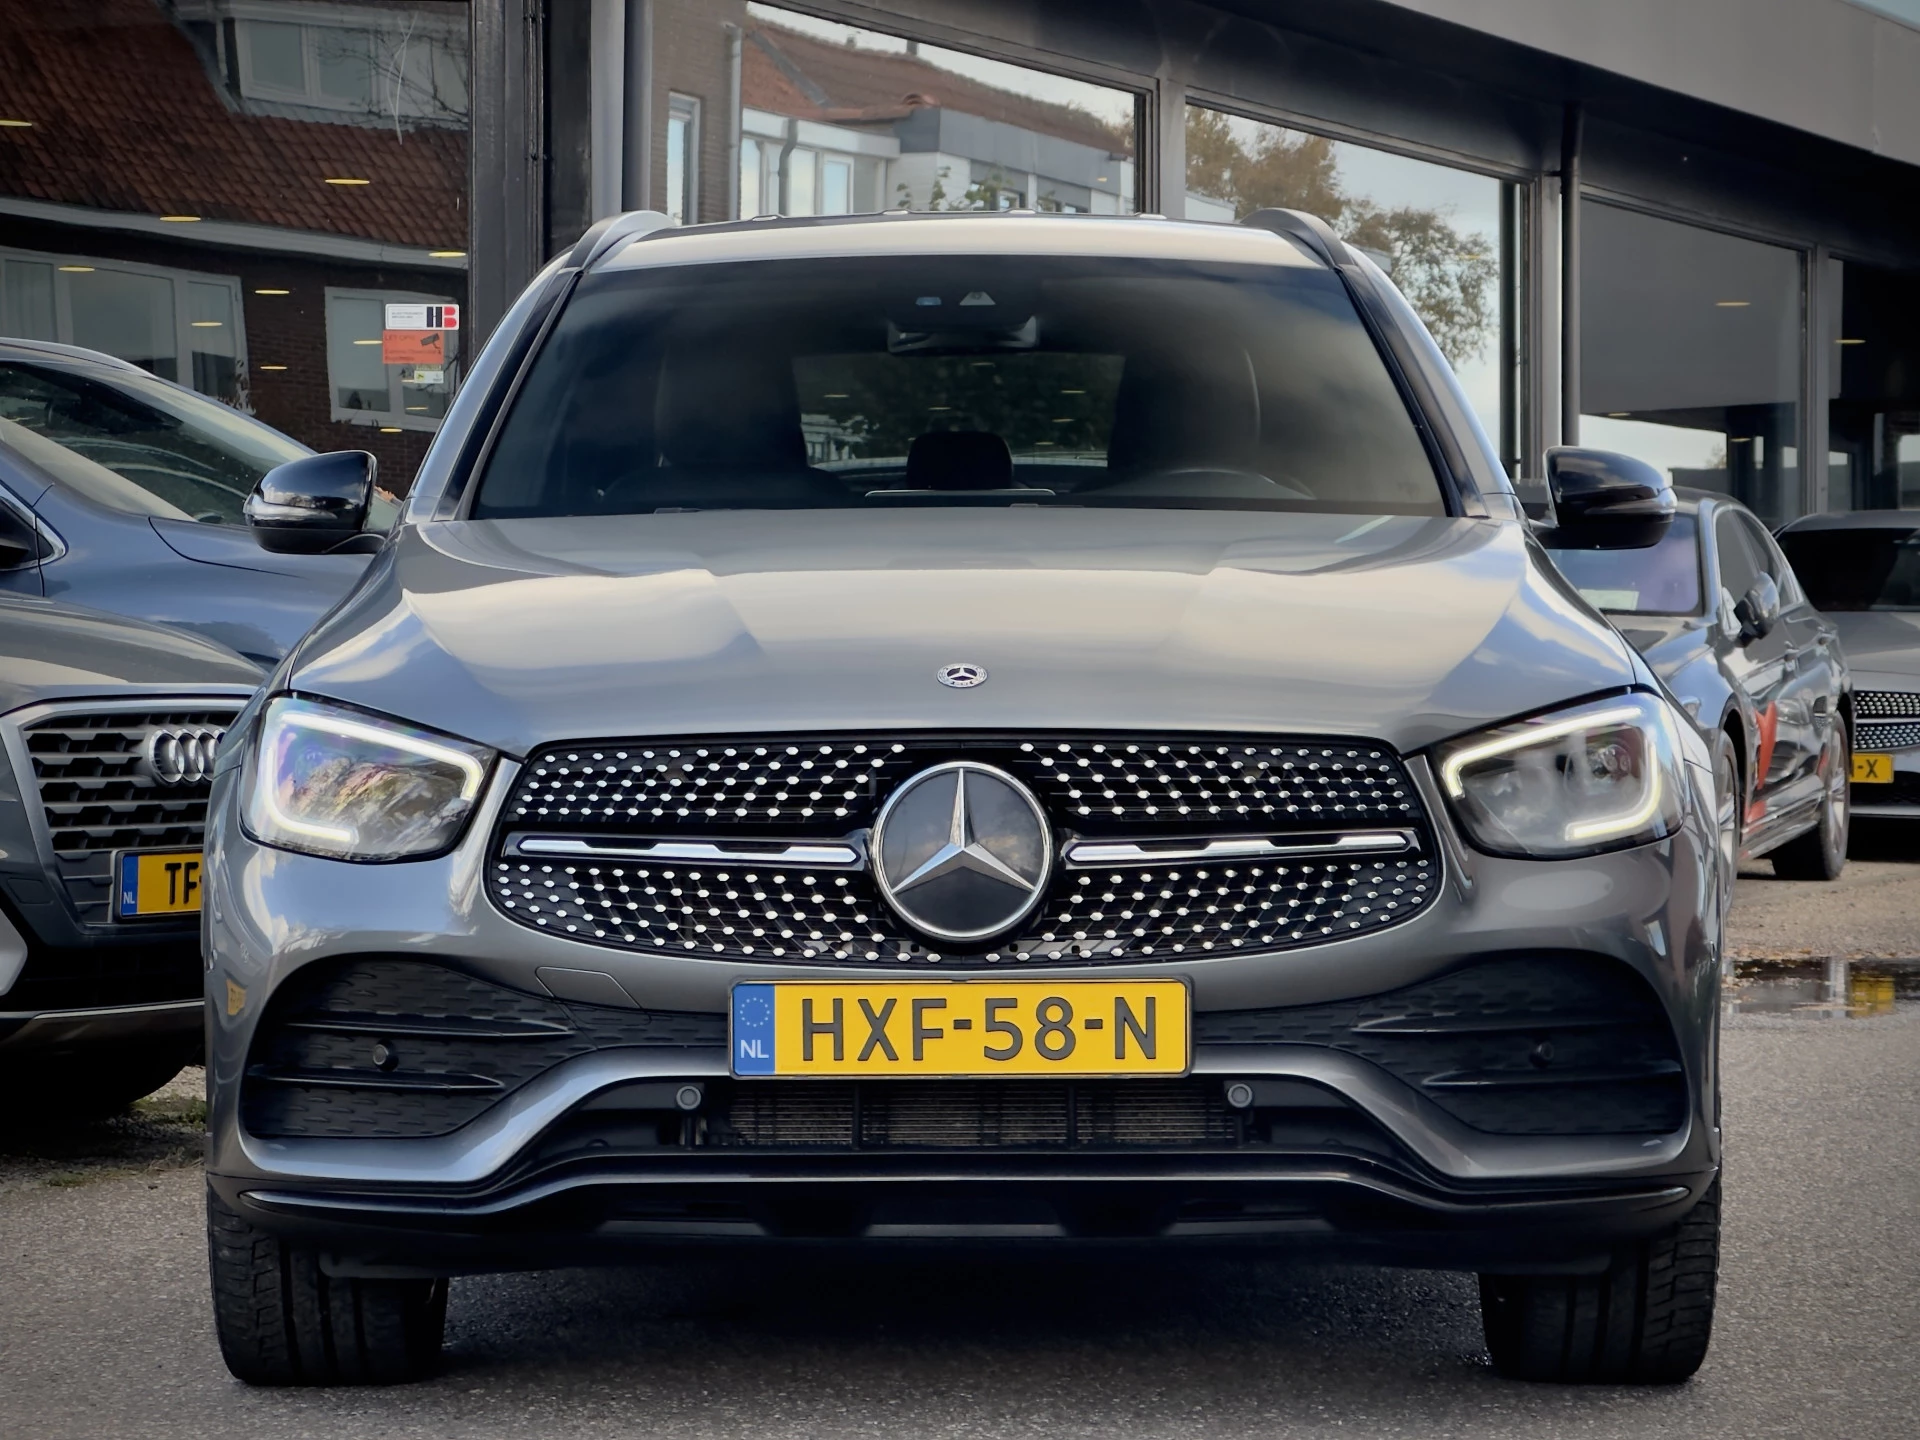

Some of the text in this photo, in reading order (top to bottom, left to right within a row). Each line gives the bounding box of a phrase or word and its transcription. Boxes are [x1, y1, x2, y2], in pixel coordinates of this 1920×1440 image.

[1851, 758, 1878, 779] -X
[123, 891, 135, 904] NL
[800, 996, 1158, 1062] HXF-58-N
[739, 1039, 769, 1060] NL
